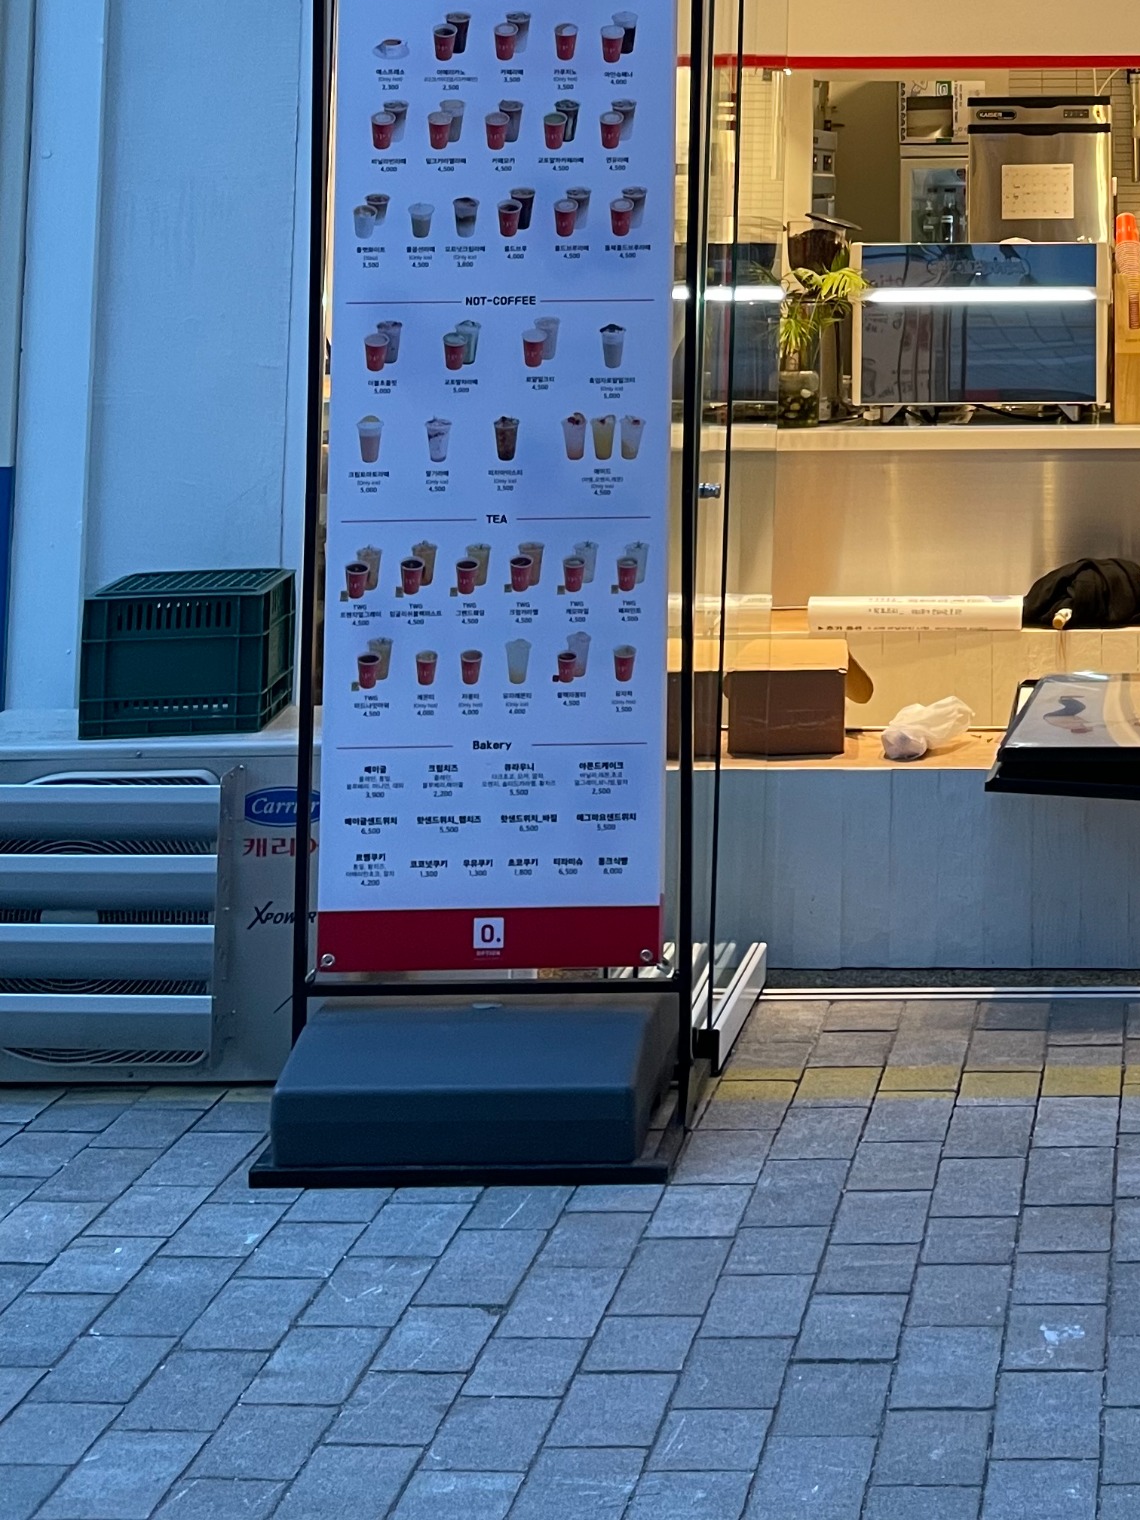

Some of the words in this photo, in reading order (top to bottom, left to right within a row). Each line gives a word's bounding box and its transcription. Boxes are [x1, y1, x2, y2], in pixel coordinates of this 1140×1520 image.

[465, 296, 537, 306] NOT-COFFEE
[485, 514, 508, 525] TEA
[352, 603, 368, 611] TWG
[408, 602, 424, 610] TWG
[462, 601, 477, 609] TWG
[622, 599, 637, 607] TWG
[472, 739, 513, 752] Bakery
[363, 764, 387, 775] 베이글
[427, 763, 459, 774] 크림치즈
[578, 761, 625, 771] 아몬드케이크
[251, 797, 320, 815] Carrir
[246, 901, 317, 930] XPOWR
